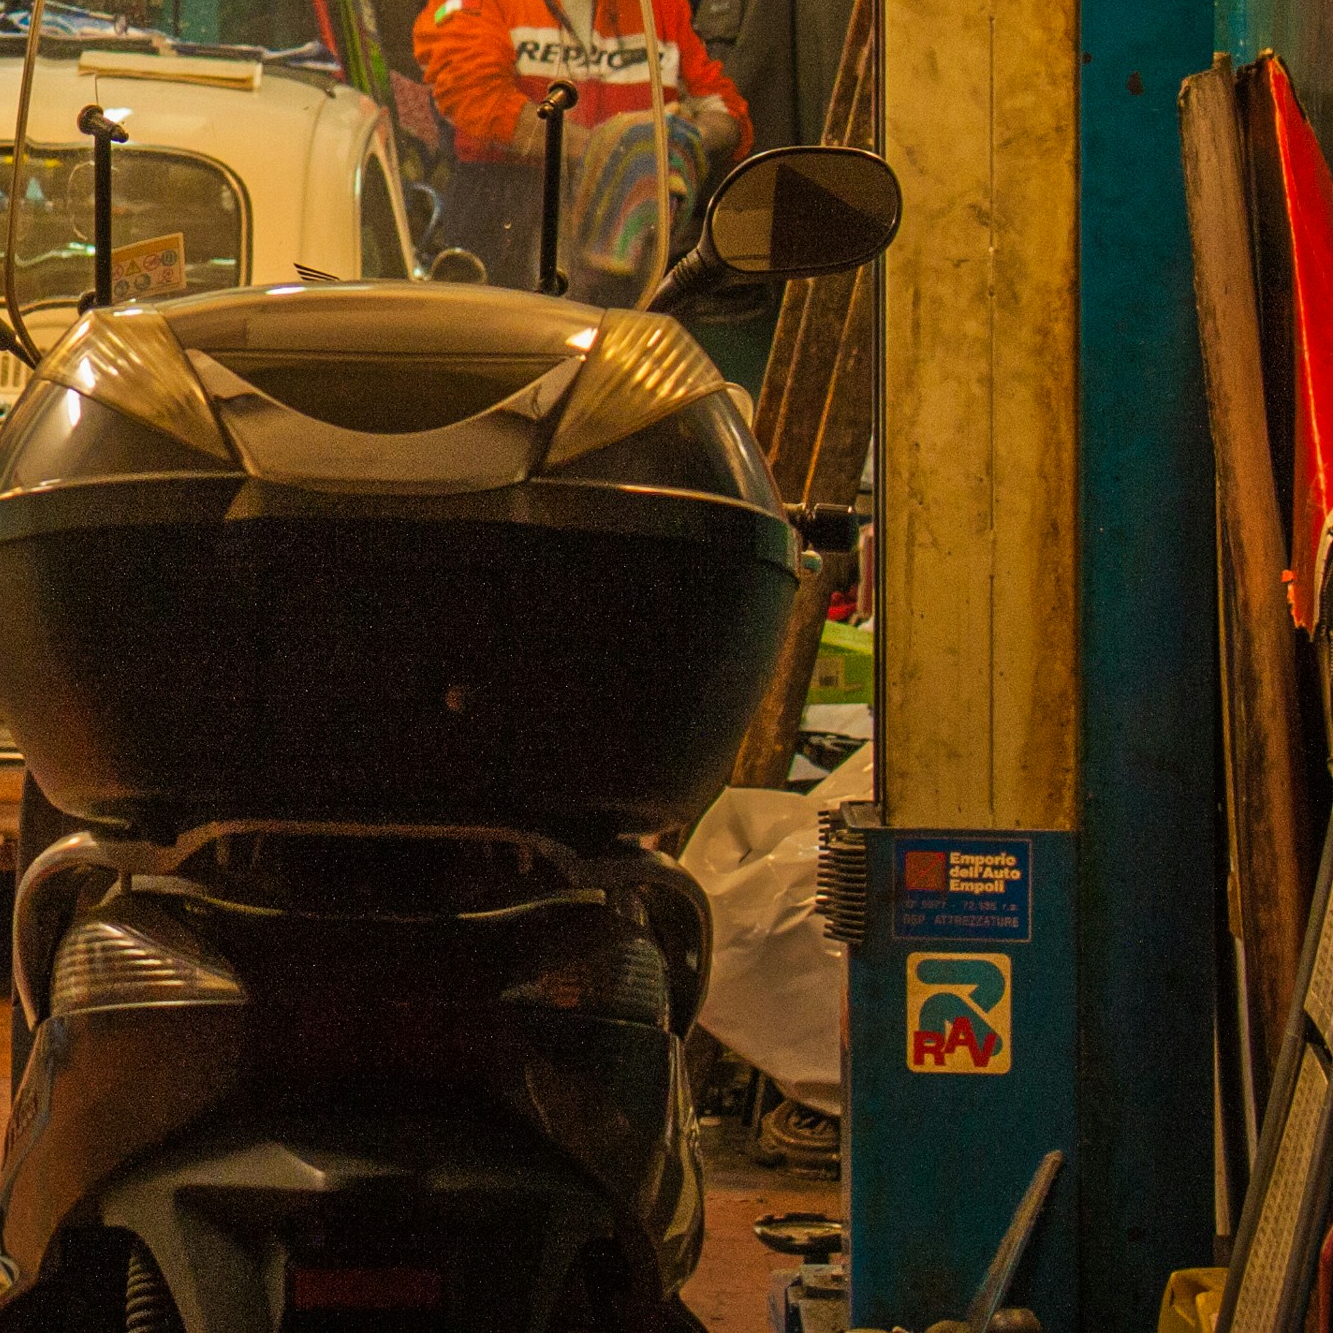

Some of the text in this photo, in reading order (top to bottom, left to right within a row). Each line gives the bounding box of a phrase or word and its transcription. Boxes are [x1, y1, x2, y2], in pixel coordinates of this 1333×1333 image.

[949, 852, 1018, 867] Emporio
[949, 865, 1022, 880] dell'Auto
[949, 879, 1006, 895] Empoli
[913, 1016, 998, 1068] RAV
